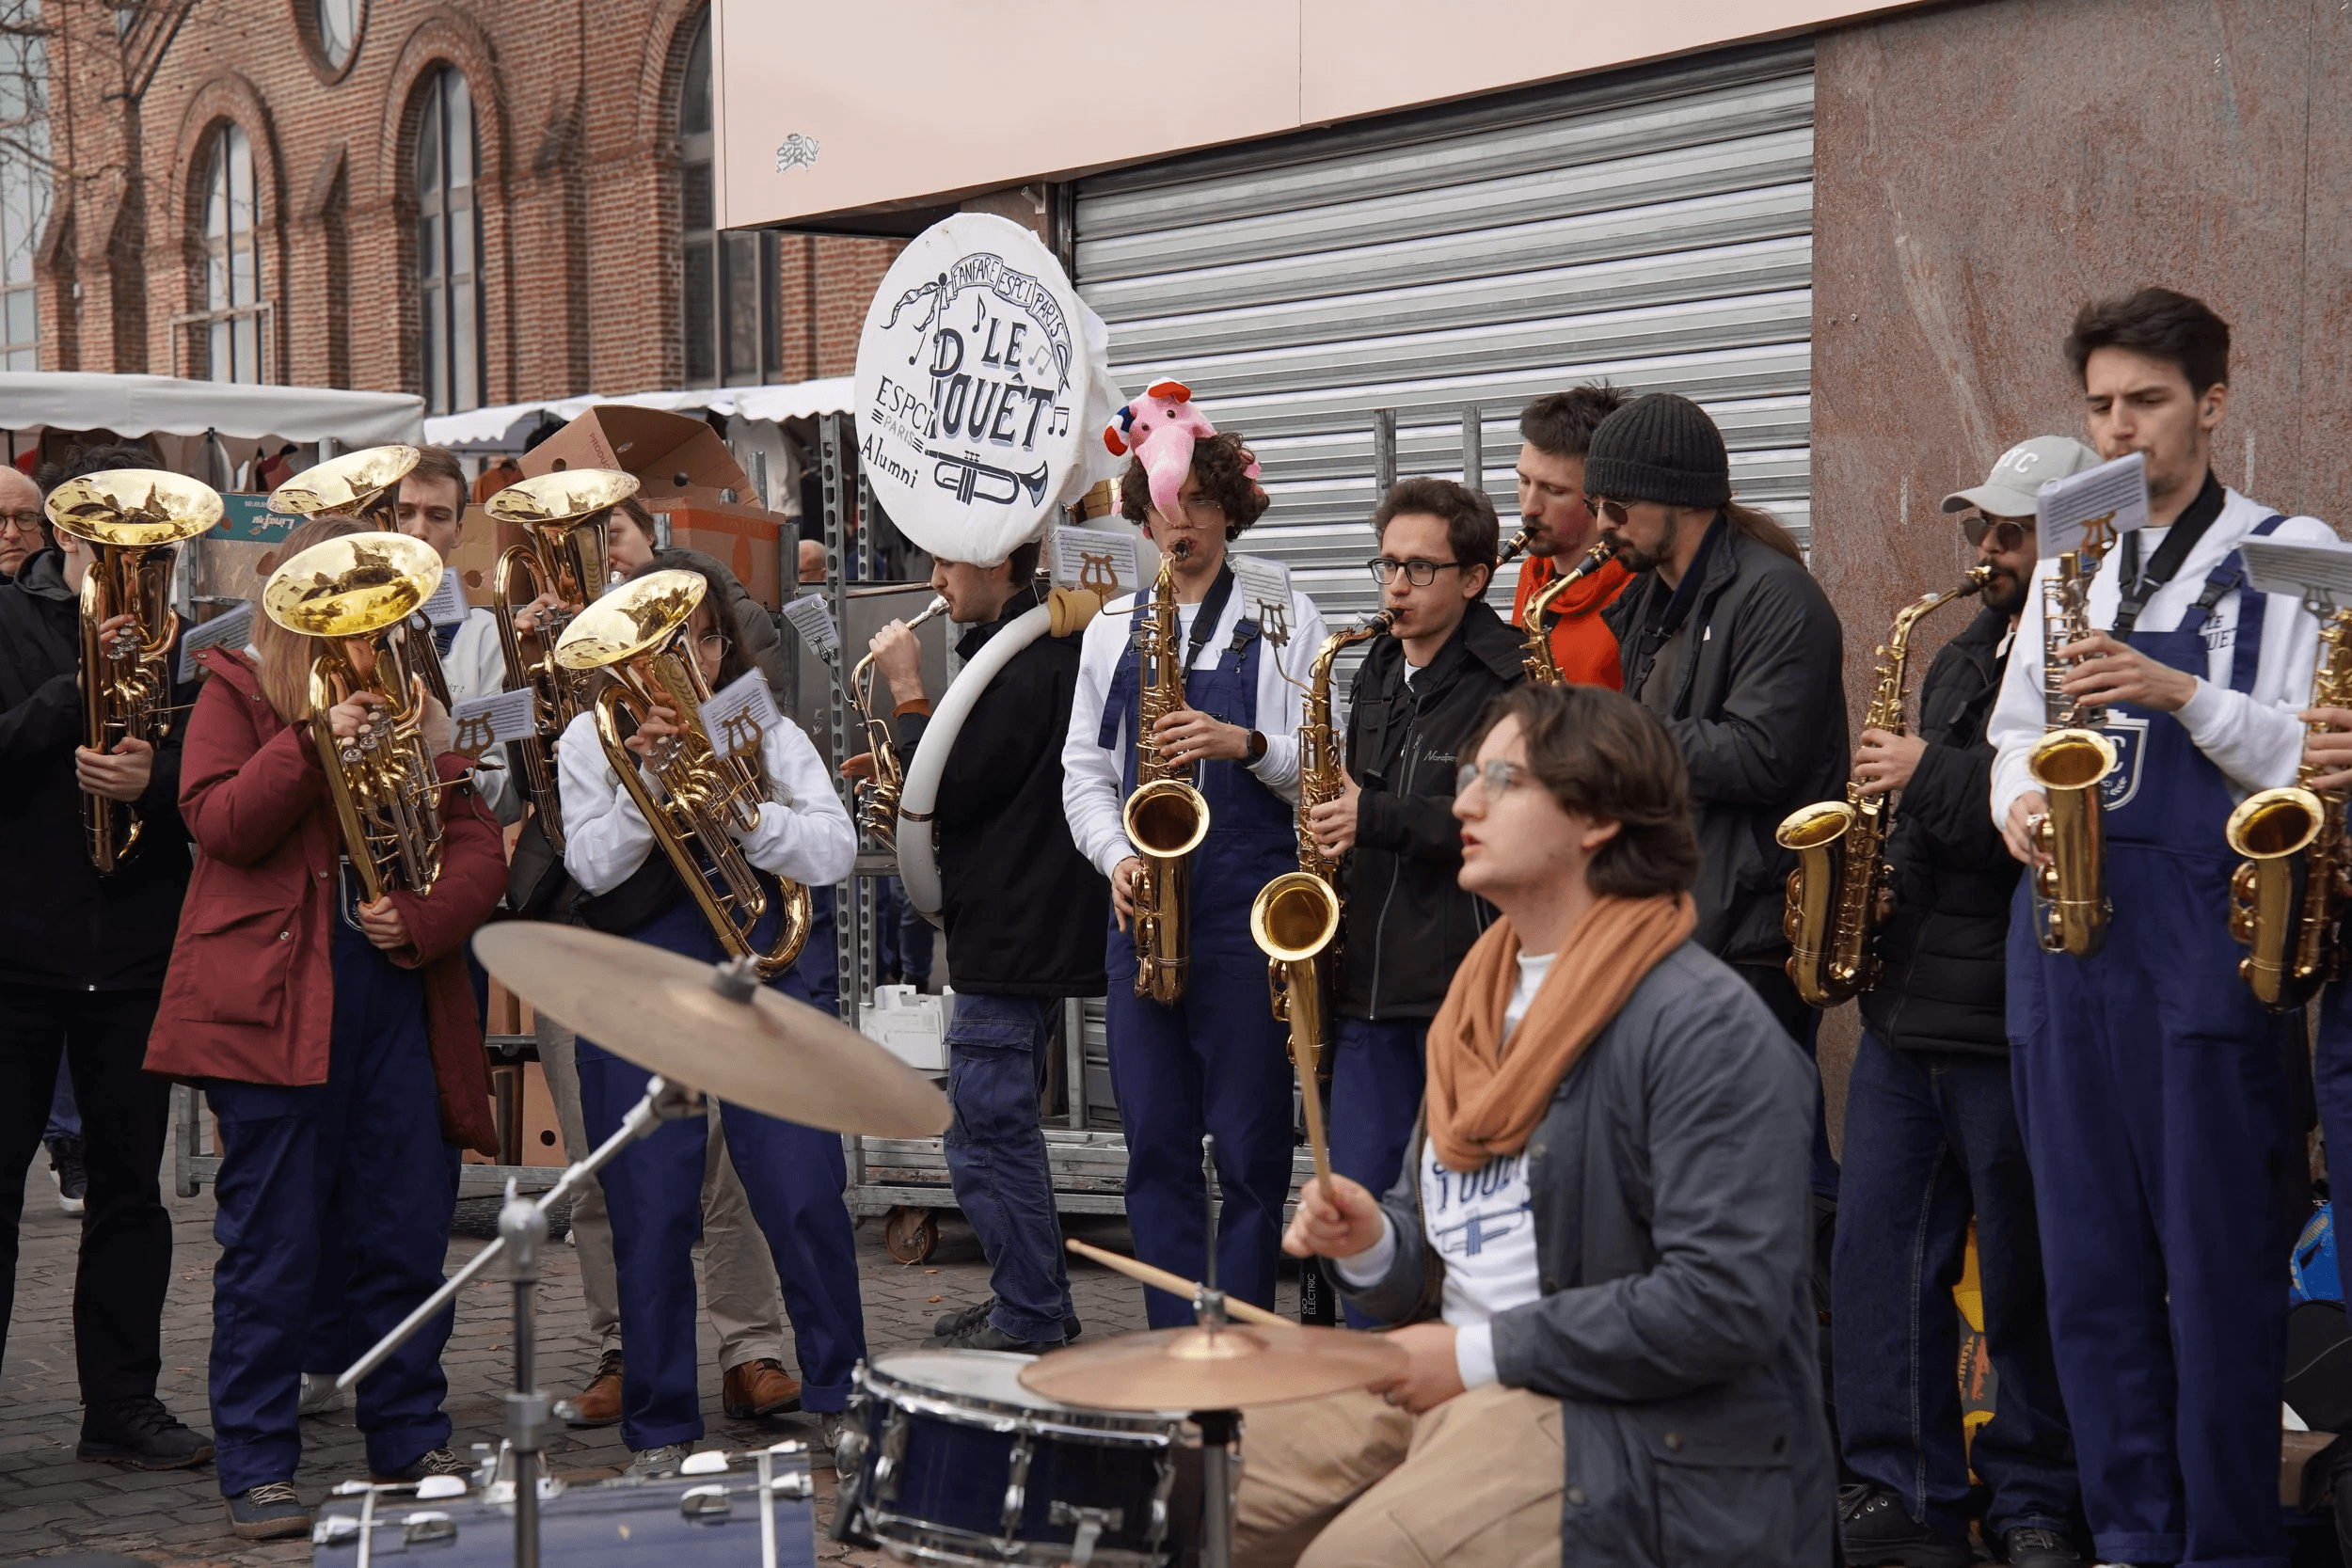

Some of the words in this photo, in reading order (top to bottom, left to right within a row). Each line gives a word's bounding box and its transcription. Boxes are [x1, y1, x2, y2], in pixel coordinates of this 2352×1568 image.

[953, 257, 1000, 290] FANFARE
[998, 272, 1033, 302] ESPCI
[1031, 293, 1064, 337] PARIS
[981, 317, 1028, 369] LE
[875, 374, 935, 436] ESPCI
[883, 415, 915, 447] PARIS
[861, 433, 919, 489] Alumni
[1301, 1298, 1309, 1314] GO
[1308, 1273, 1316, 1315] ELECTRIC
